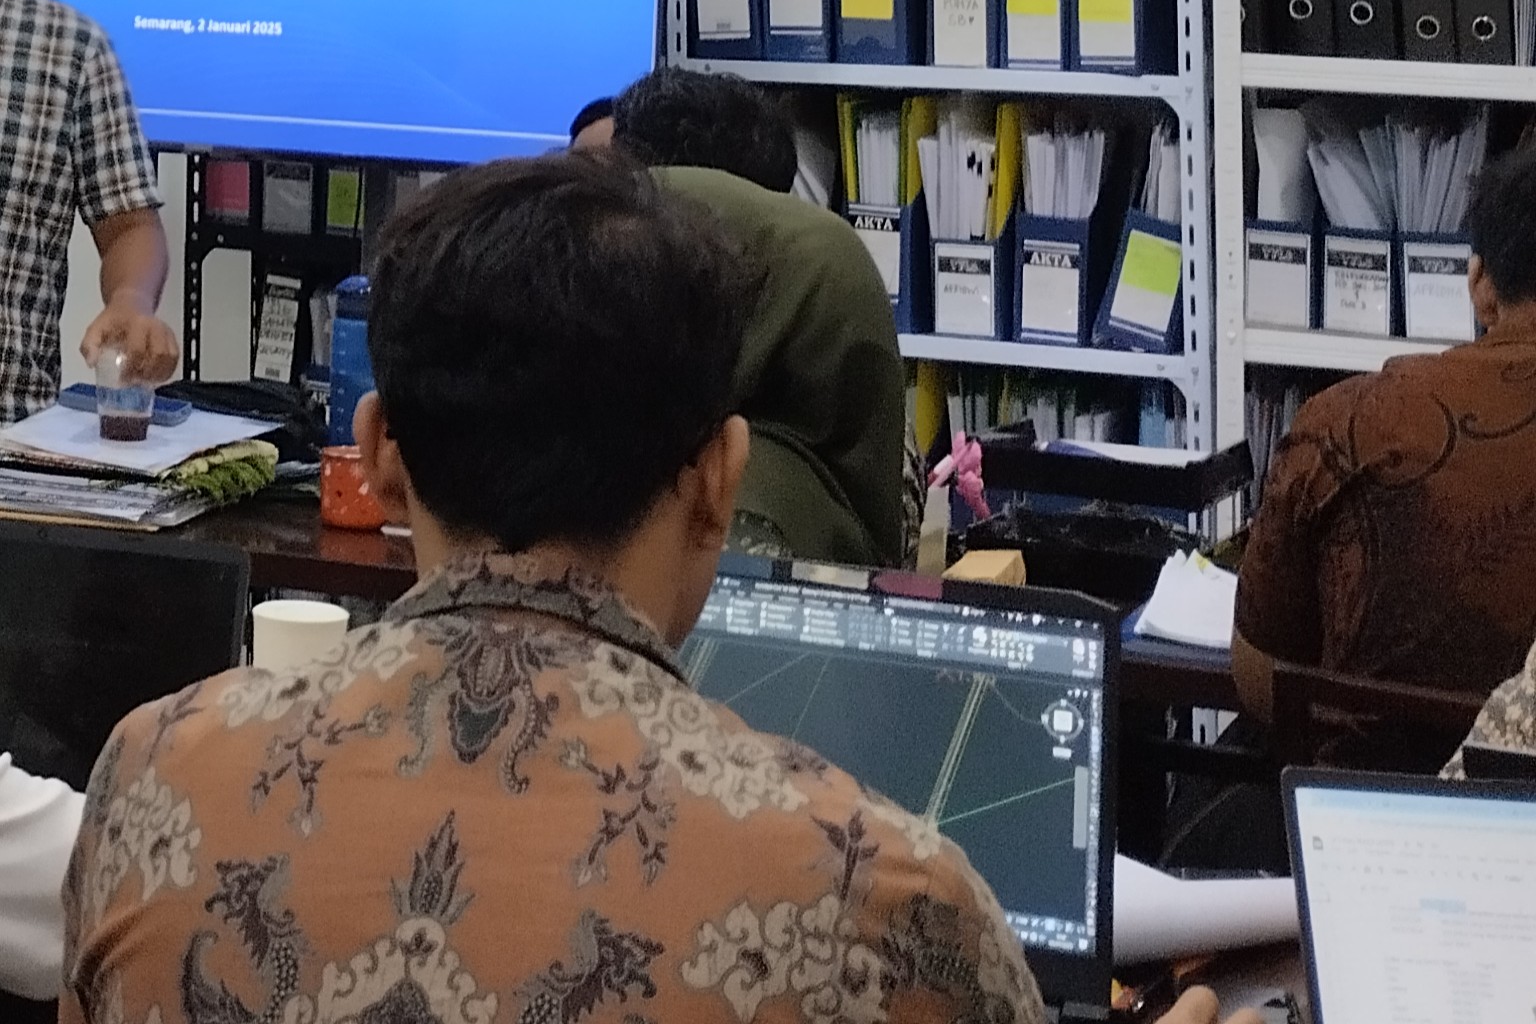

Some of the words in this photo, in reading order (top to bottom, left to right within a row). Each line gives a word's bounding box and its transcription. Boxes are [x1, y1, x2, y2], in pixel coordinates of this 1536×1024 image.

[133, 14, 196, 35] Semarang,
[197, 17, 206, 32] 2
[207, 18, 251, 35] Januari
[252, 20, 284, 36] 2025
[854, 215, 894, 231] AKTA
[1029, 251, 1072, 268] AKTA
